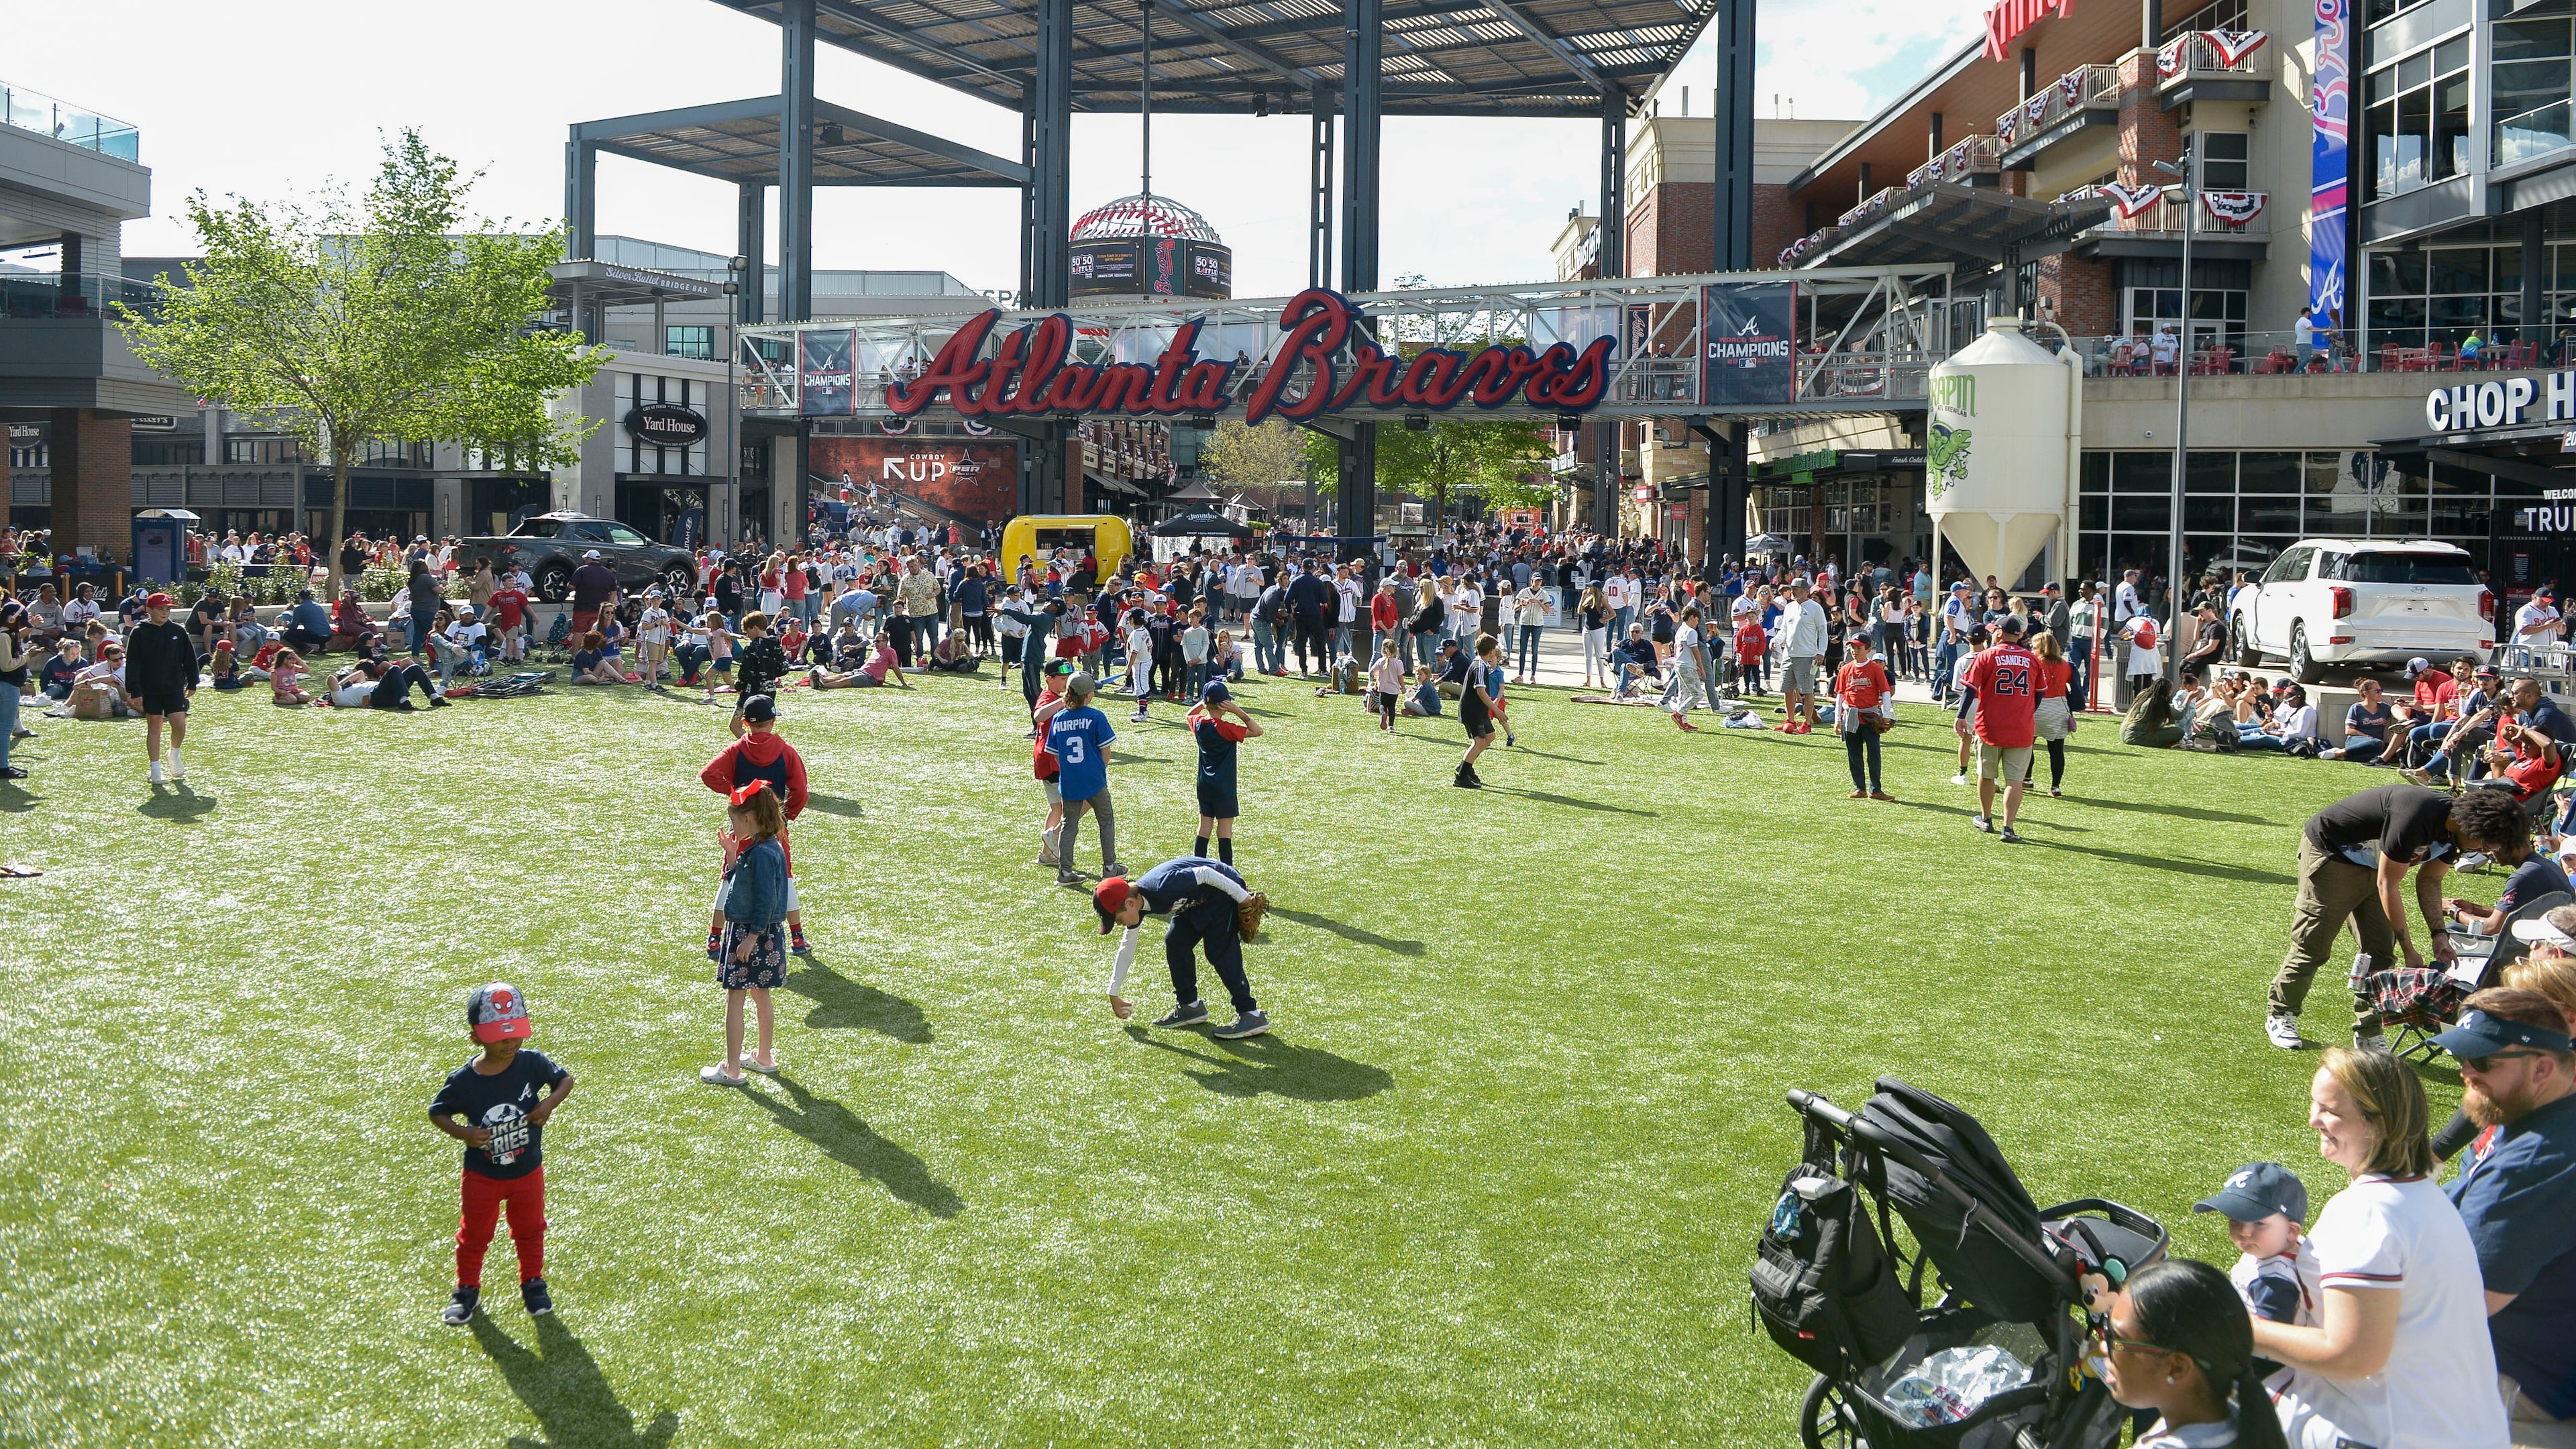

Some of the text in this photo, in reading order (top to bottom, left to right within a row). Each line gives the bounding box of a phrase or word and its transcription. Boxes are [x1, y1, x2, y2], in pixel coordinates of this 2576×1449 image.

[606, 266, 708, 294] Silver Bullet BRIDGE BAR
[1245, 287, 1617, 427] Braves
[1708, 339, 1789, 358] CHAMPIONS
[885, 307, 1237, 420] Atlanta
[804, 373, 851, 386] CHAMPIONS
[2426, 377, 2537, 431] CHOP
[9, 425, 40, 437] Yard House
[643, 416, 696, 433] Yard House
[910, 462, 946, 482] UP
[1608, 586, 1618, 597] 10
[1994, 654, 2031, 668] DSANDERS
[1995, 667, 2030, 696] 24
[1053, 718, 1093, 732] MURPHY
[1066, 736, 1085, 763] 3
